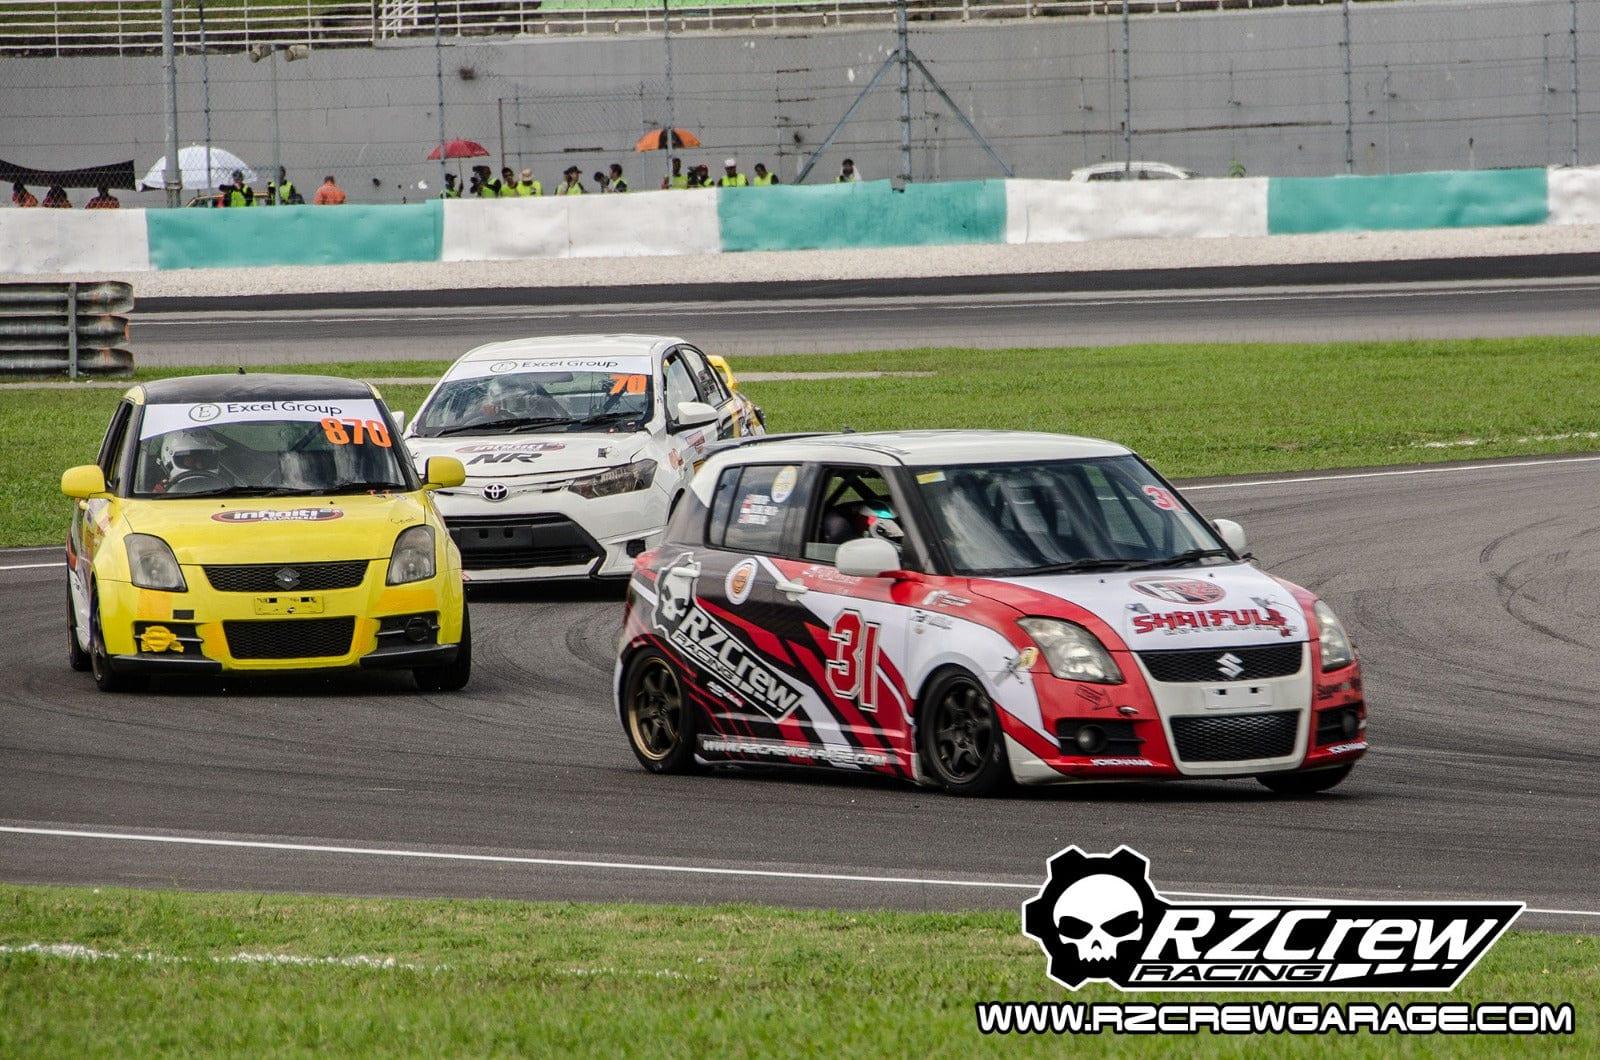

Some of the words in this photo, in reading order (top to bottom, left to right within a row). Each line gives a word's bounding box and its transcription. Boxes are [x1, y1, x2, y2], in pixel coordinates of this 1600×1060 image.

[522, 360, 563, 369] Excel
[566, 359, 619, 370] Group
[609, 373, 648, 396] 70
[227, 401, 278, 414] Excel
[281, 400, 343, 417] Group
[320, 417, 393, 449] 870
[466, 452, 543, 466] NR
[679, 605, 799, 710] RZCrew
[825, 607, 882, 713] 31
